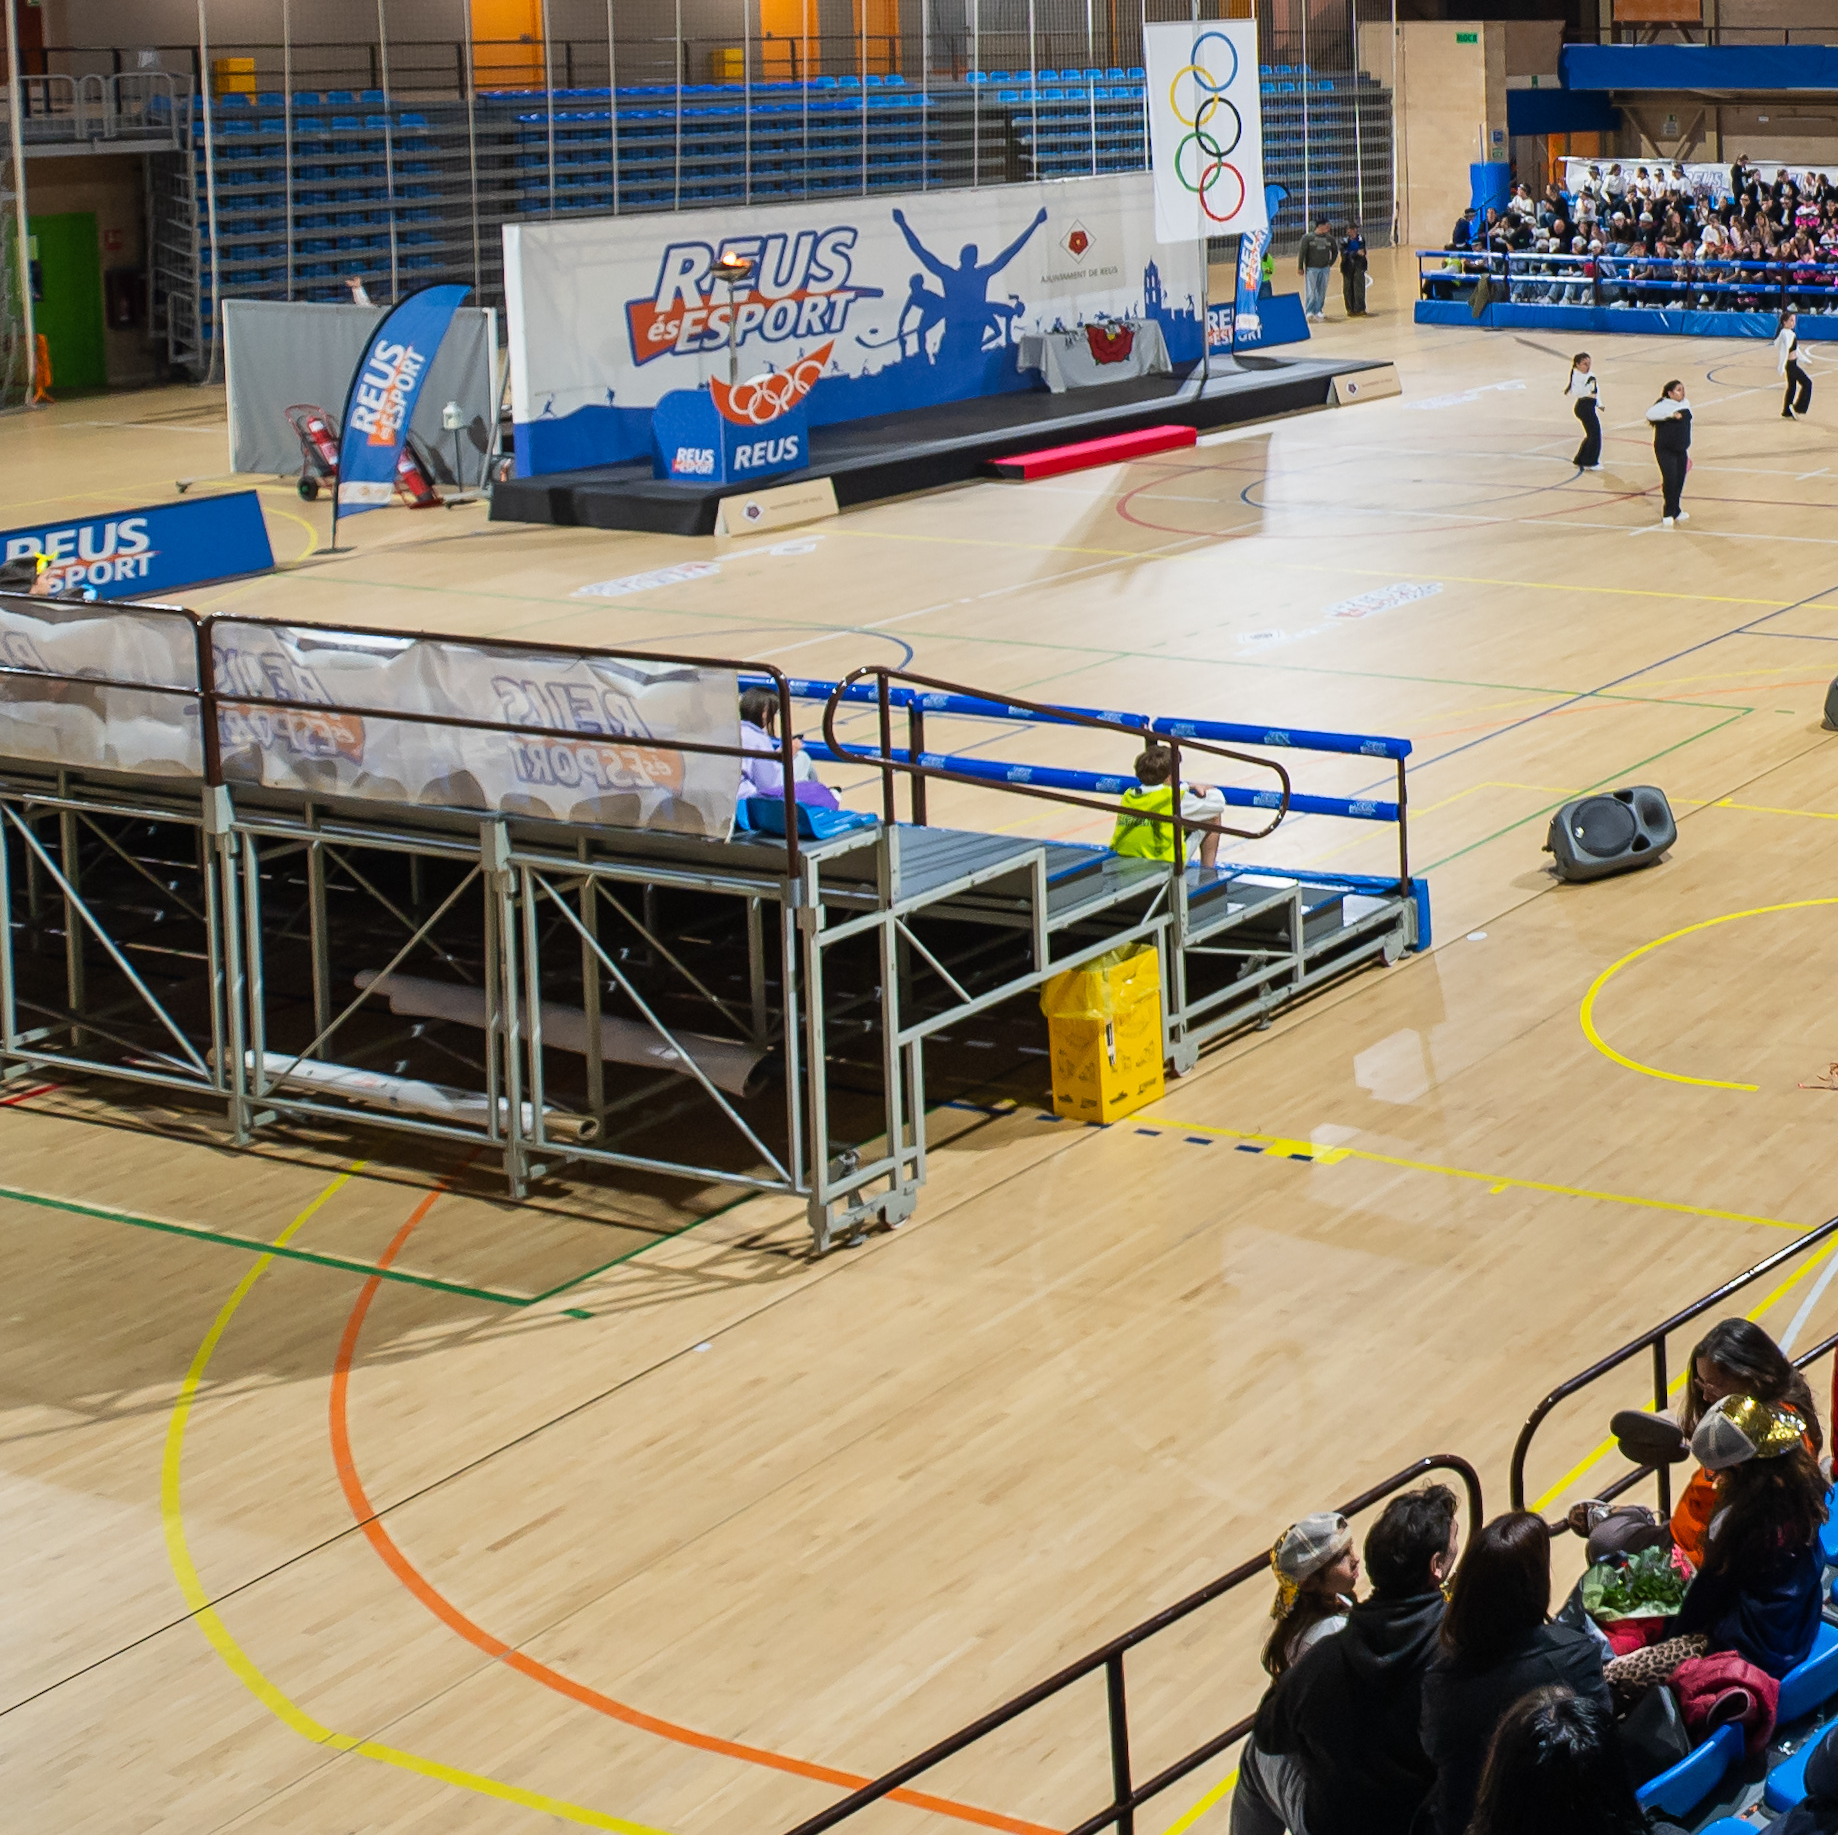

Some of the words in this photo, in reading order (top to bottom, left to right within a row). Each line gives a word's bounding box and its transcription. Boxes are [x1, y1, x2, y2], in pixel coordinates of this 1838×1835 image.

[655, 226, 859, 313] REUS
[1089, 268, 1098, 277] DE
[1240, 230, 1257, 280] REU
[647, 314, 680, 343] és
[671, 291, 857, 356] ESPORT
[351, 339, 406, 435] REUS
[387, 345, 426, 430] ESPORT
[676, 447, 715, 462] REUS
[733, 435, 799, 471] REUS
[6, 517, 151, 567] REUS
[48, 552, 156, 594] SPORT
